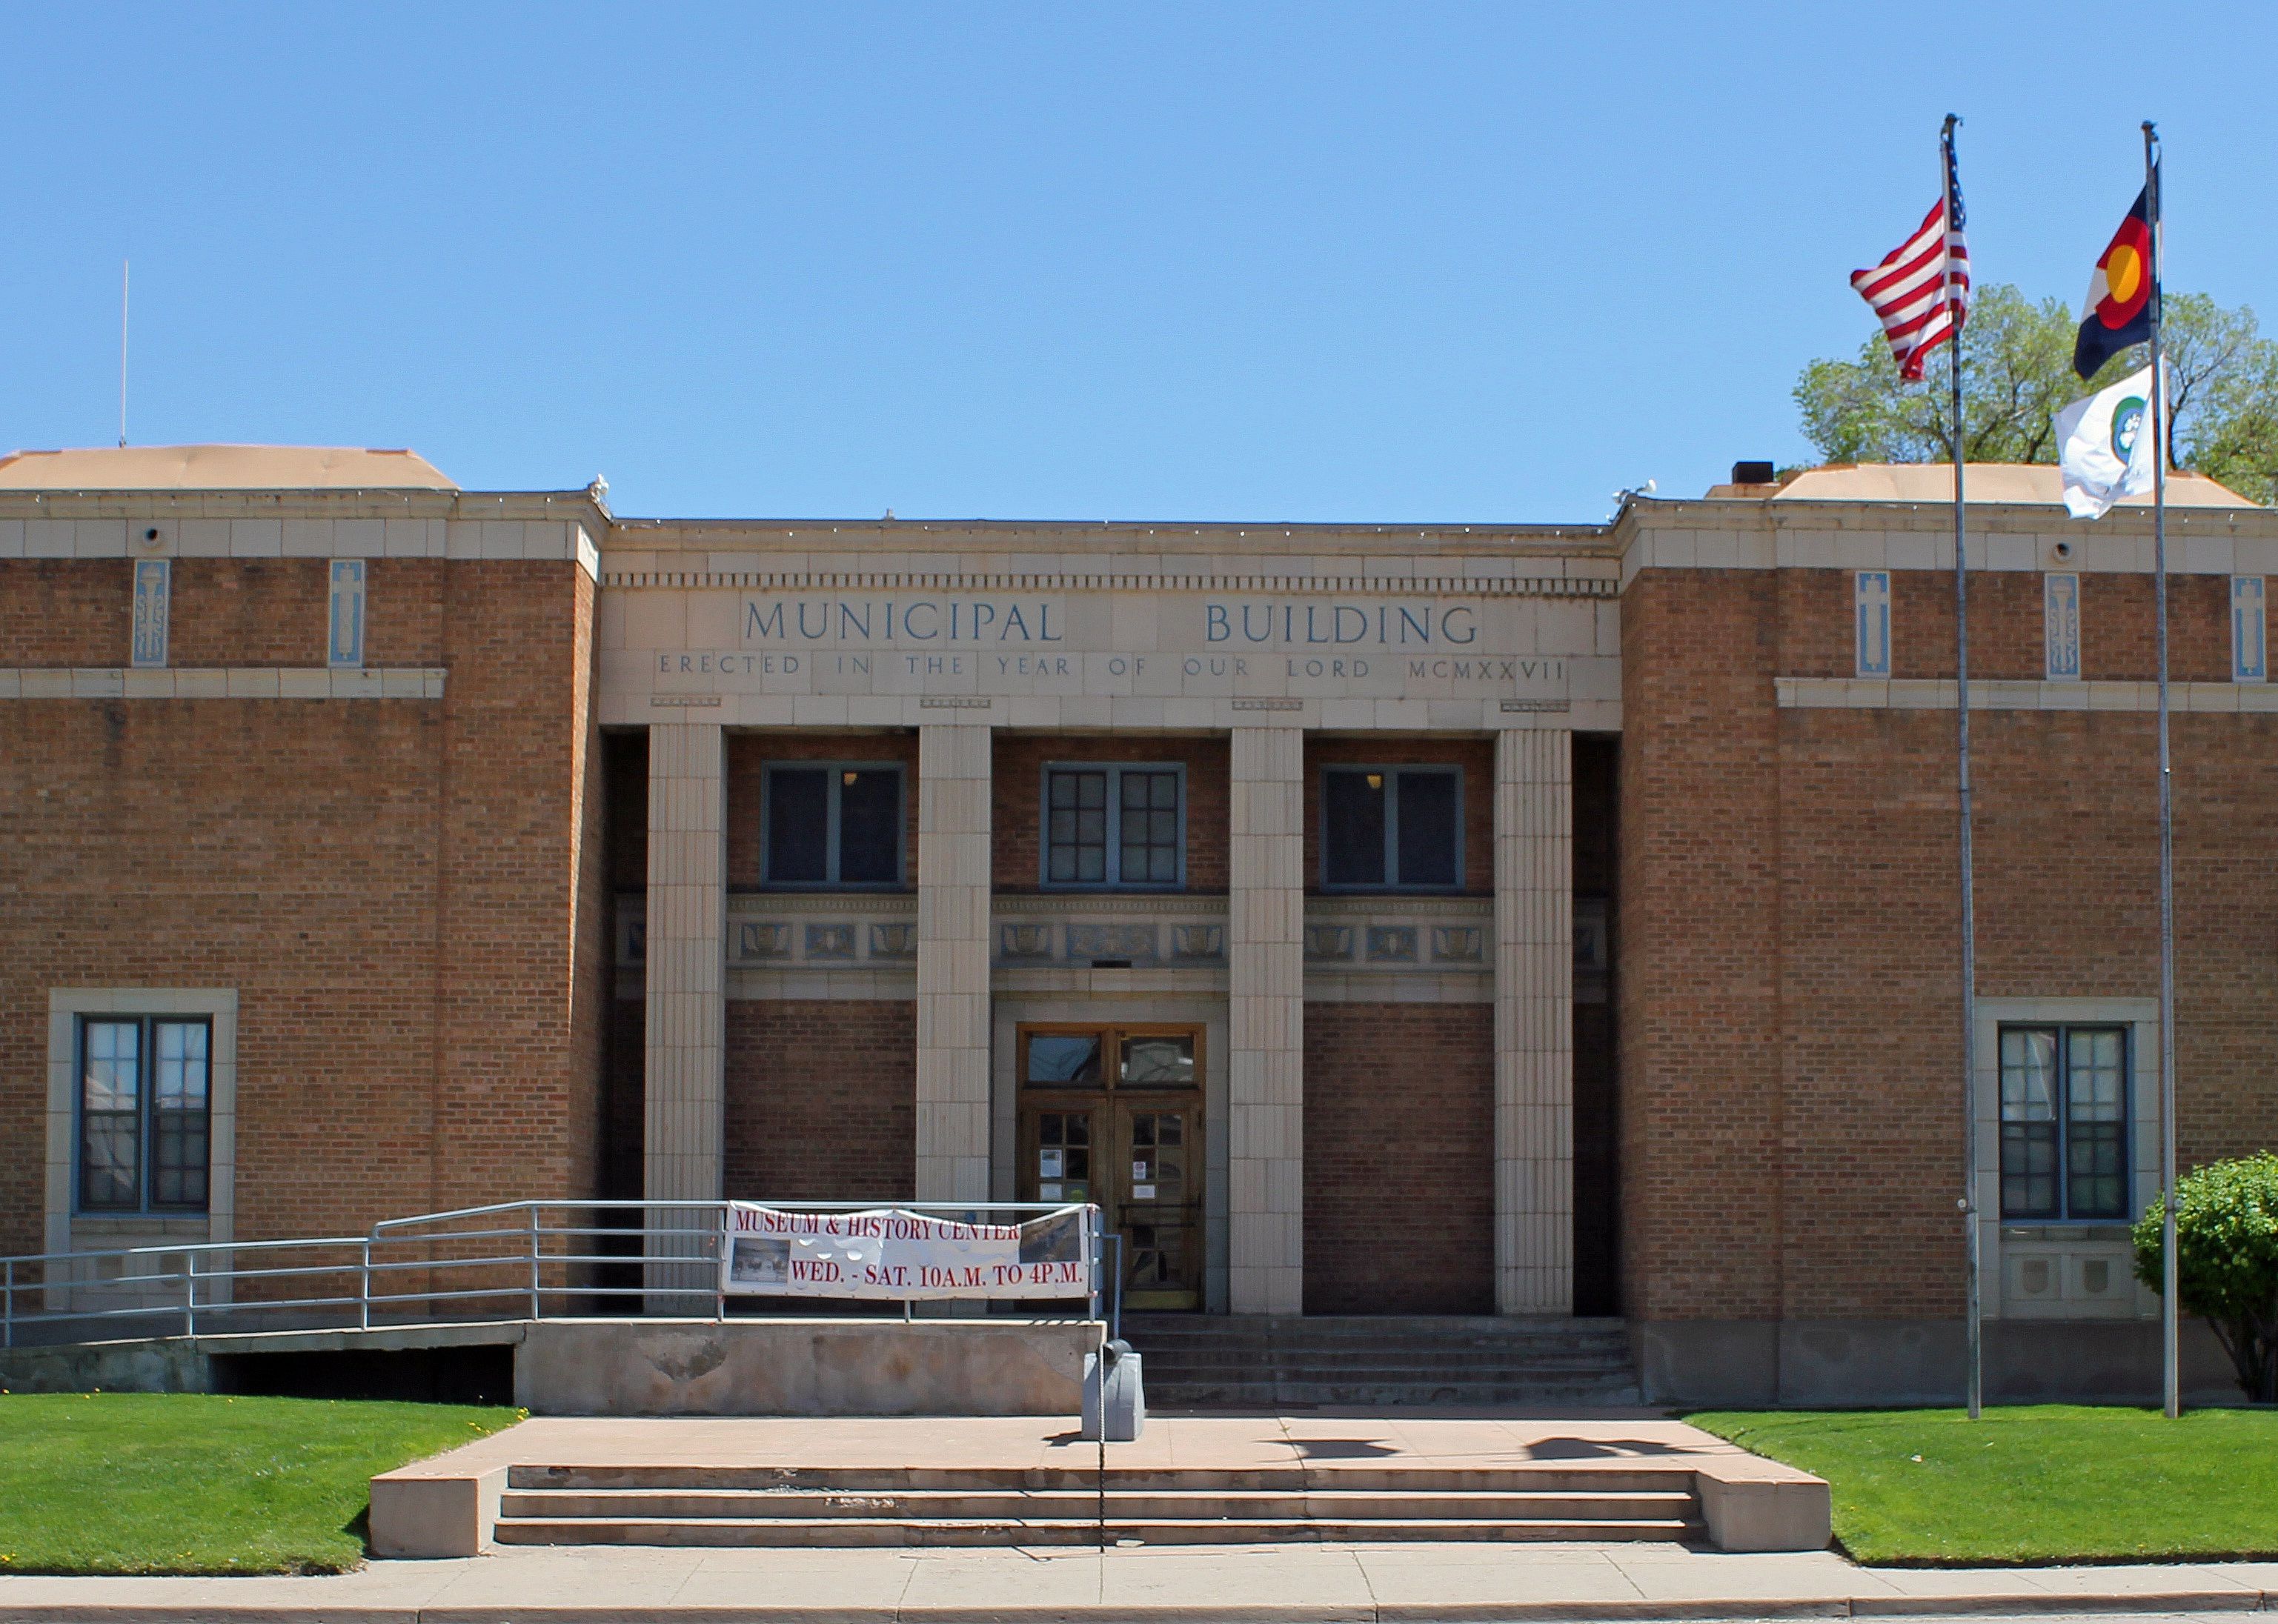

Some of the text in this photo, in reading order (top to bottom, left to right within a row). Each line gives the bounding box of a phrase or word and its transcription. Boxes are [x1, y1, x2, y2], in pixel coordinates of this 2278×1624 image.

[746, 602, 1478, 645] MUNICIPAL BUILDING
[660, 655, 1564, 681] ERECTED IN THE YEAR OF OUR LORD MCMXXVII
[734, 1210, 1020, 1241] MUSEUM & HISTORY CENTER
[791, 1260, 845, 1283] WED.
[865, 1264, 912, 1287] SAT.
[920, 1266, 987, 1288] 10A.M.
[993, 1264, 1023, 1285] TO
[1029, 1262, 1083, 1284] 4P.M.
